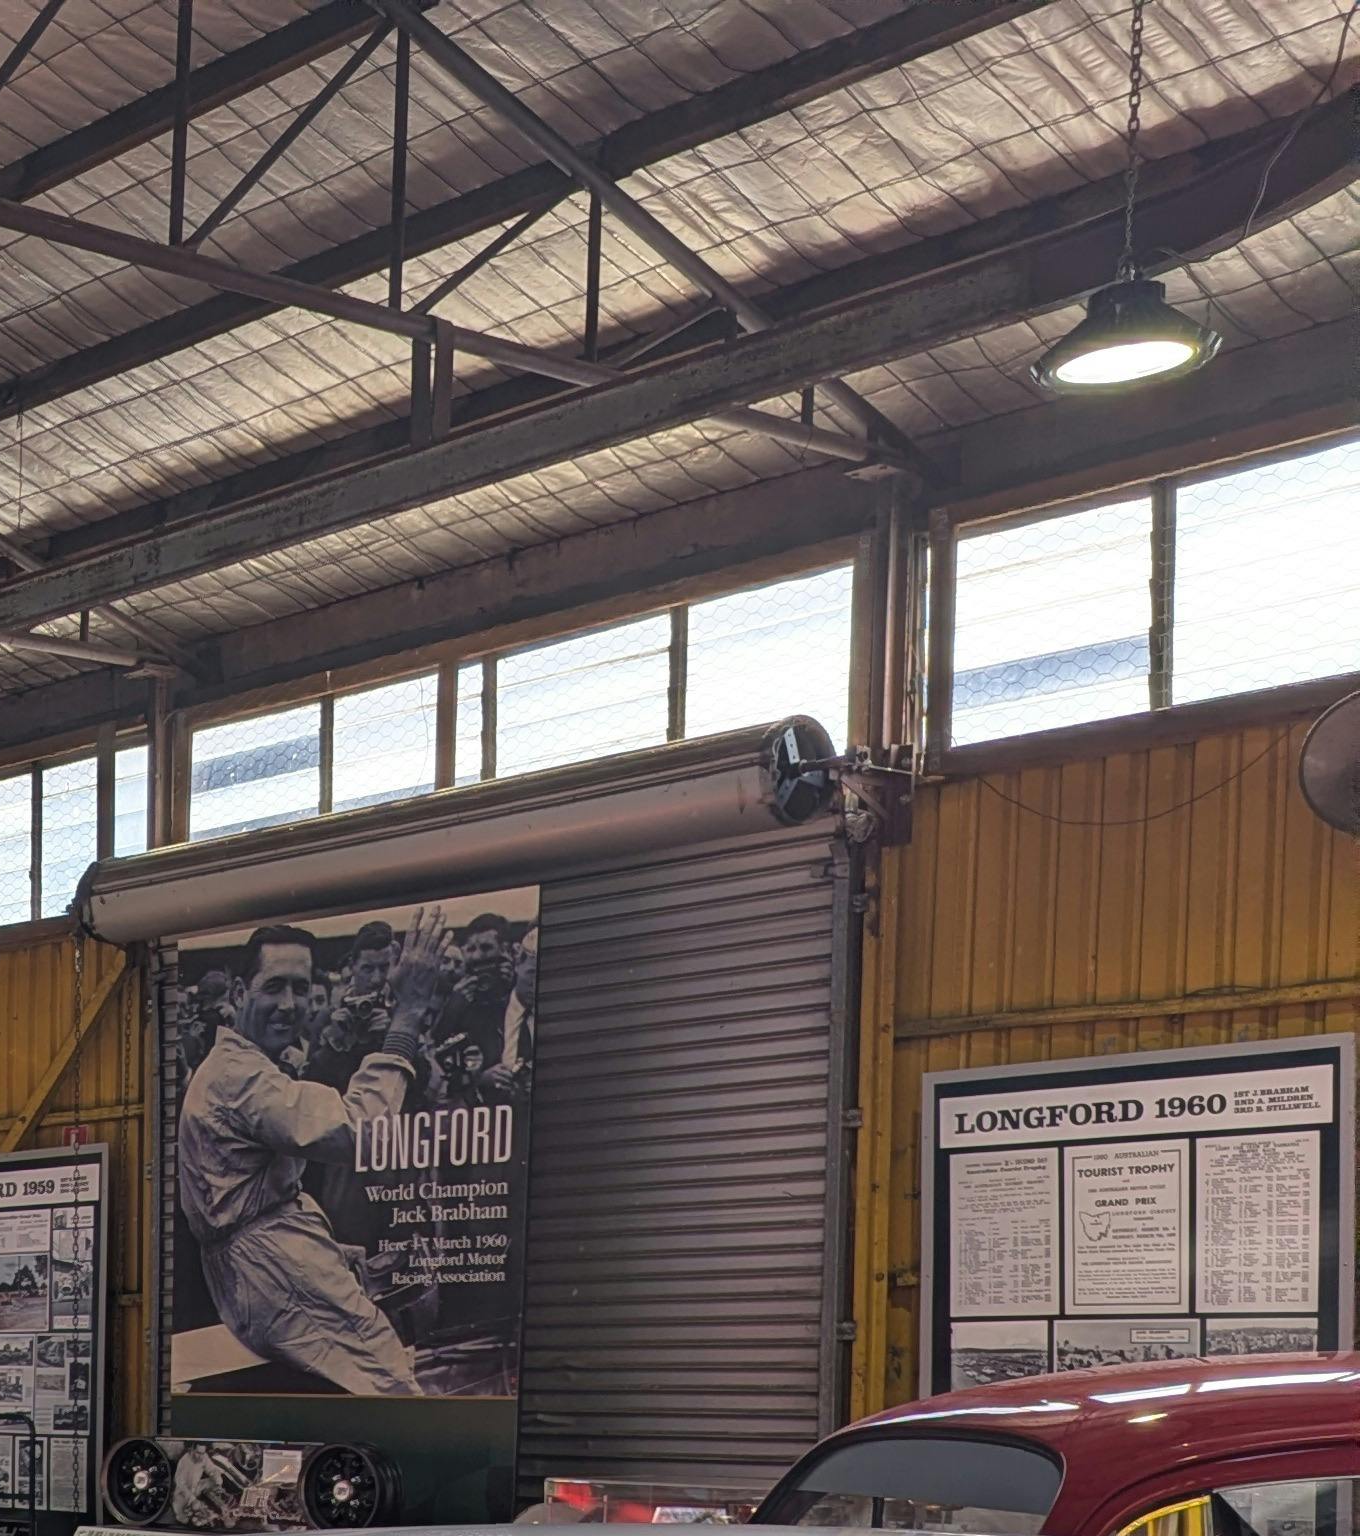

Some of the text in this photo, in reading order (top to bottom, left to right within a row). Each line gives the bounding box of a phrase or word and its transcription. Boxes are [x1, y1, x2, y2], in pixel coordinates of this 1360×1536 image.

[1260, 1086, 1309, 1095] BRABHAM
[1269, 1094, 1313, 1103] MILDREN
[954, 1094, 1227, 1135] LONGFORD 1960
[1266, 1102, 1321, 1112] STILLWELL
[355, 1104, 513, 1173] LONGFORD
[1114, 1150, 1159, 1159] AUSTRALIAN
[1077, 1163, 1175, 1178] TOURIST TROPHY
[22, 1180, 55, 1195] 1959
[365, 1180, 508, 1202] World Champion
[1095, 1197, 1157, 1207] GRAND PRIX
[389, 1203, 508, 1228] Jack Brabham
[379, 1234, 507, 1251] Here March 1960
[409, 1252, 507, 1269] Longford Motor
[392, 1269, 505, 1286] Racing Association
